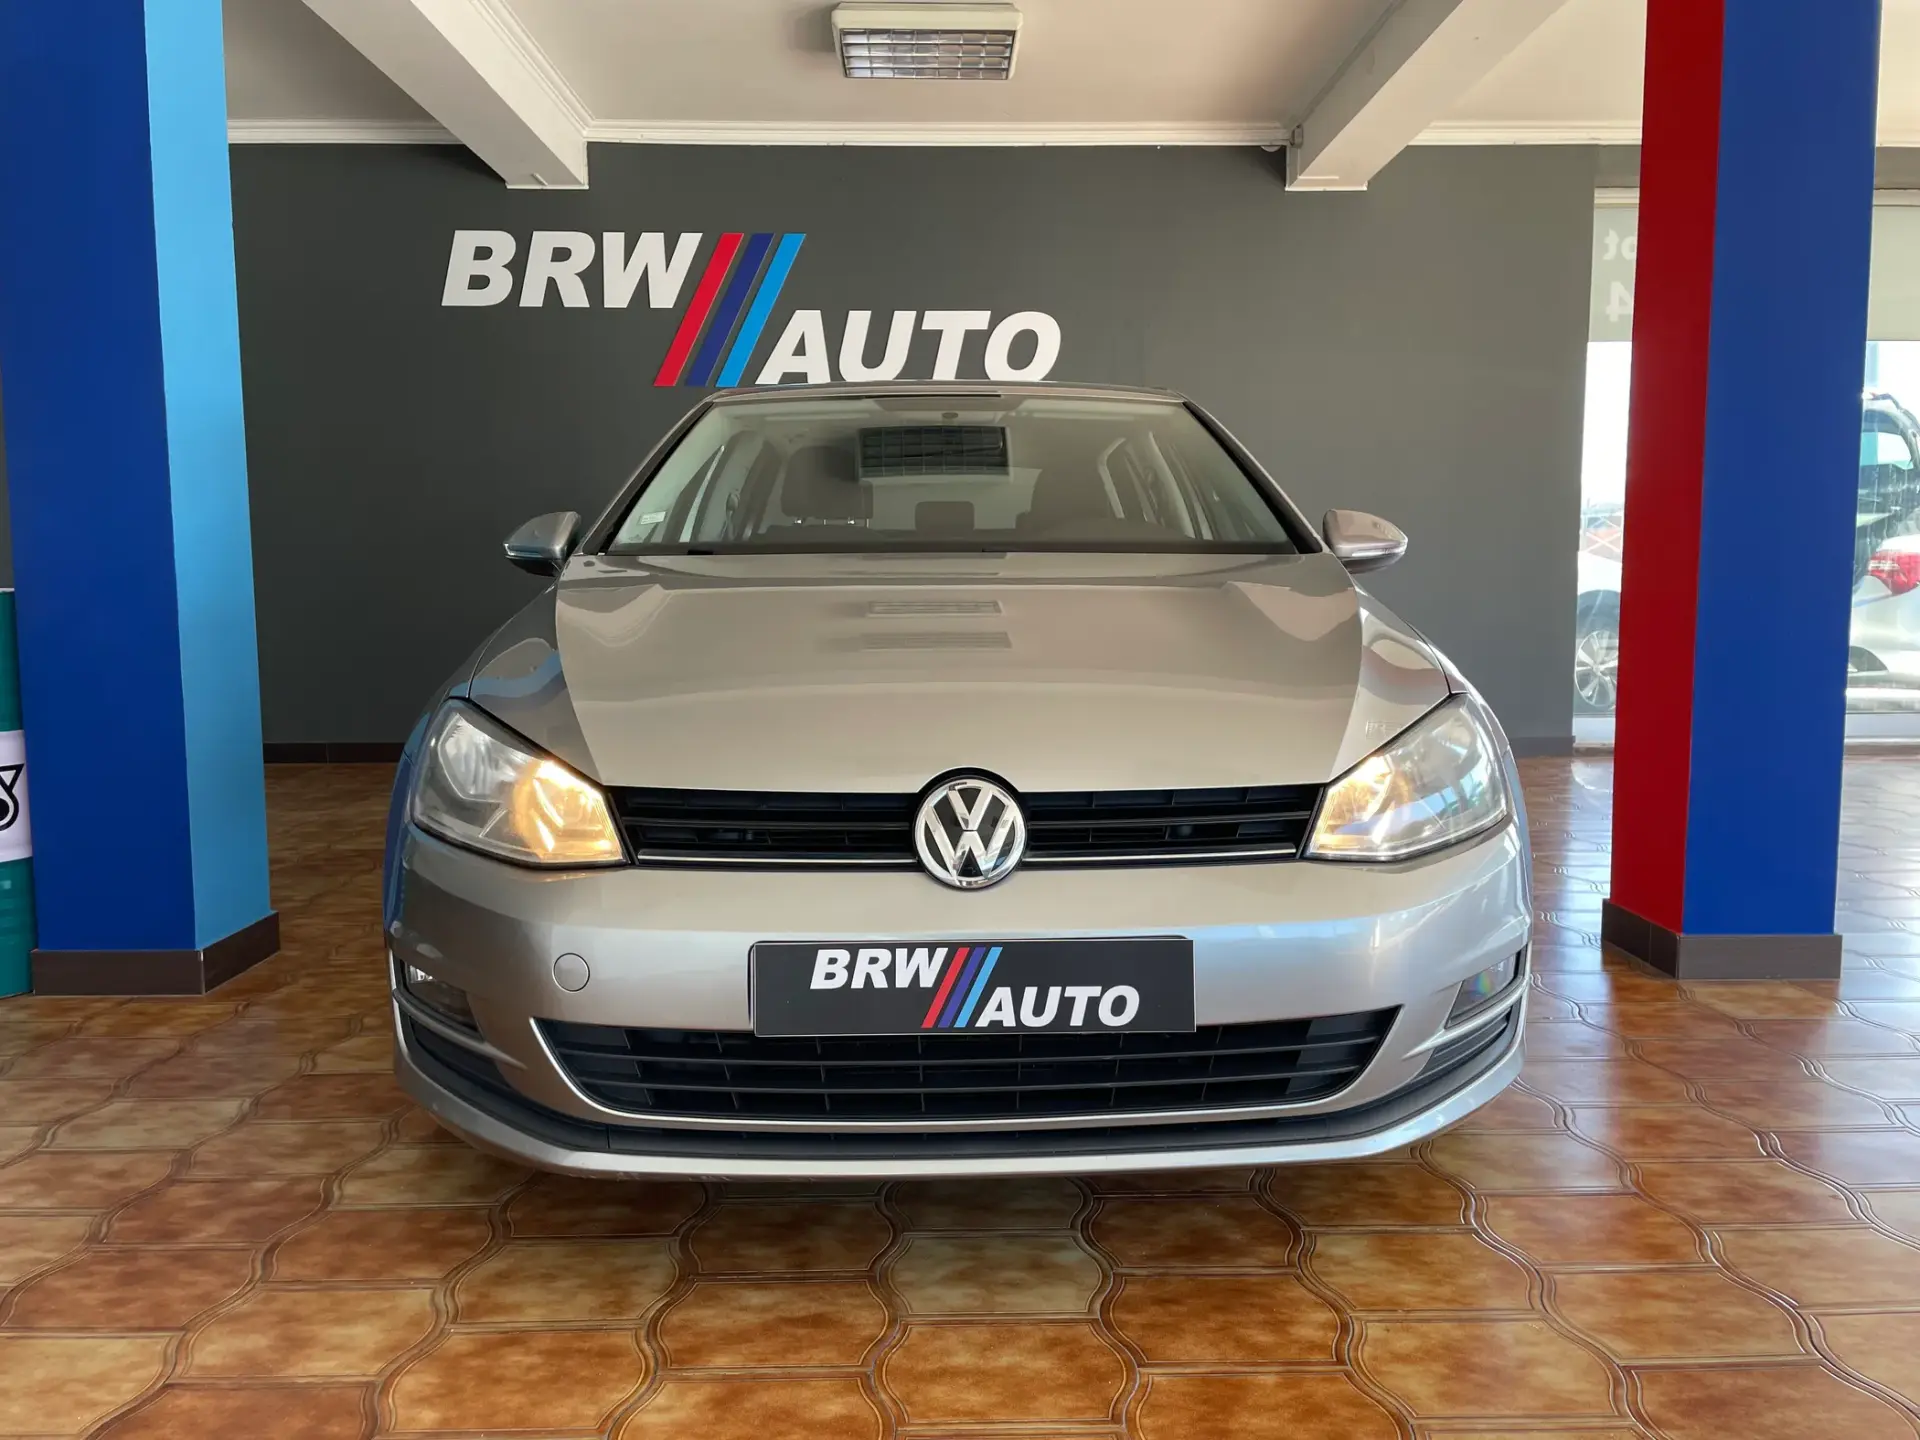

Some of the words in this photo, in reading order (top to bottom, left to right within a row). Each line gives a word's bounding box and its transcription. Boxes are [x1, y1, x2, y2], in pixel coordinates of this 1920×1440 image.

[441, 230, 703, 308] BRW
[755, 309, 1061, 385] AUTO
[918, 781, 1022, 886] VW
[810, 947, 948, 989] BRW
[975, 986, 1140, 1028] AUTO
